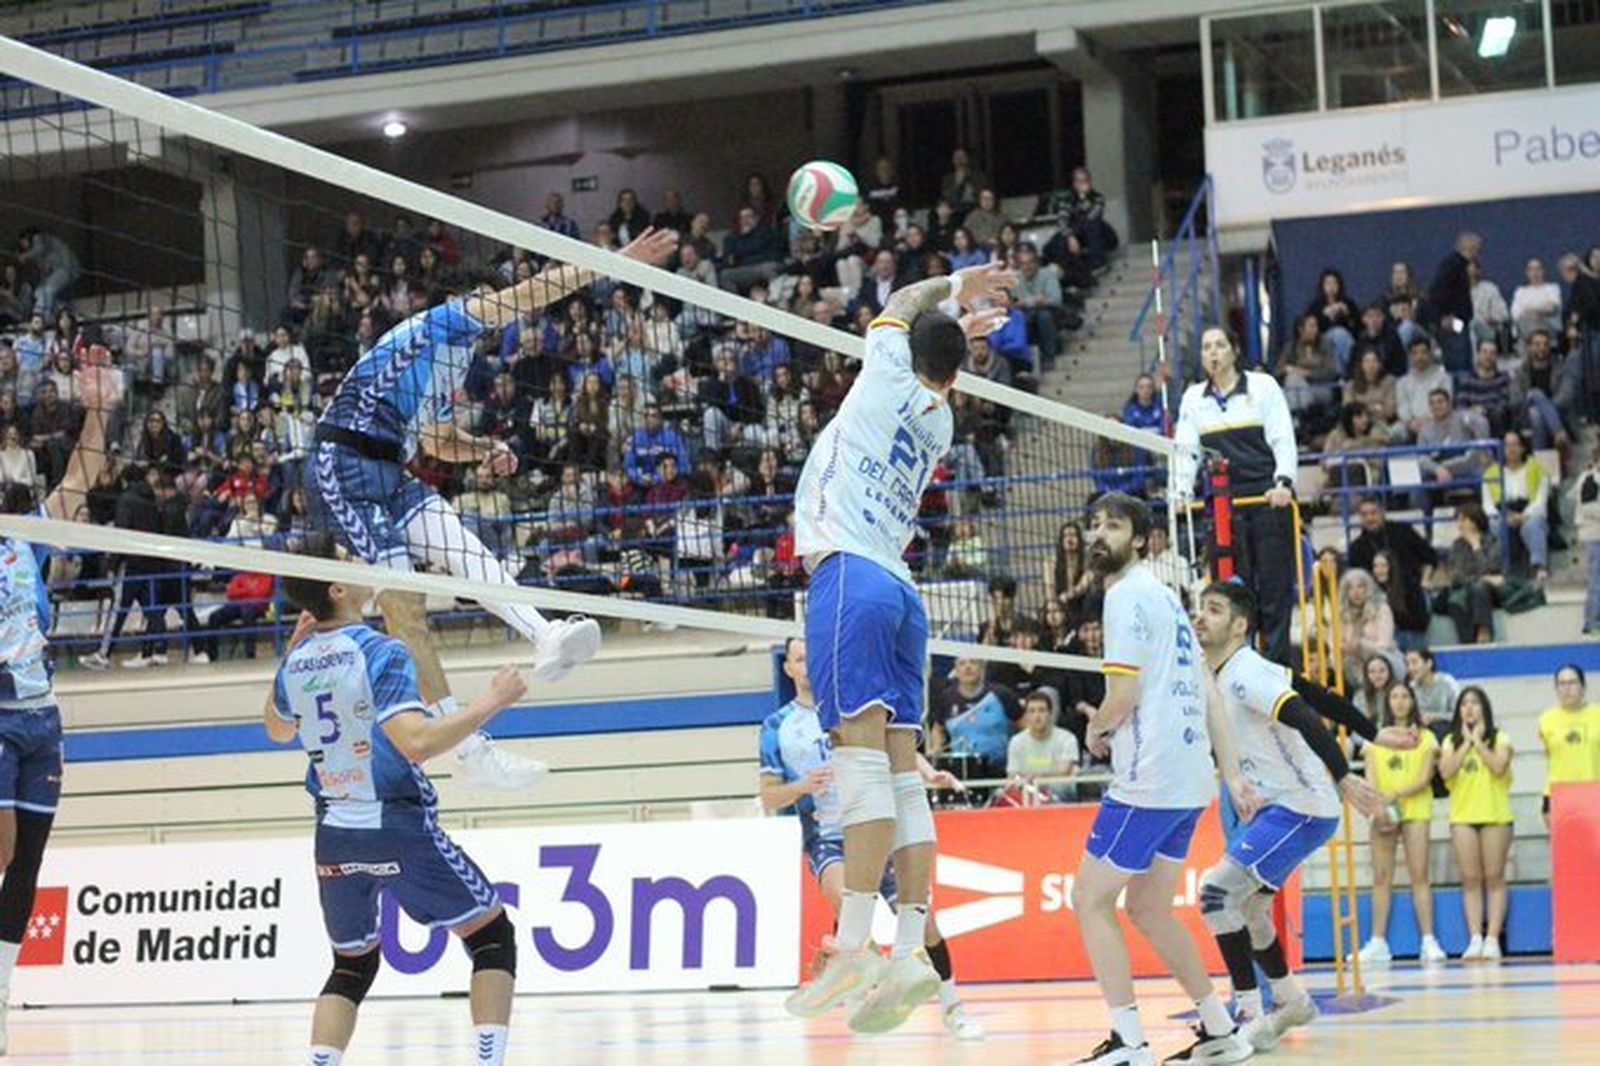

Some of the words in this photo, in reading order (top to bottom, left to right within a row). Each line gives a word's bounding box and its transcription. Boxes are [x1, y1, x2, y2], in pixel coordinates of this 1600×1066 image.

[1302, 140, 1406, 174] Leganés
[1493, 124, 1600, 166] Pabe
[316, 692, 341, 744] 5
[76, 878, 282, 916] Comunidad
[73, 930, 121, 965] de
[136, 924, 278, 963] Madrid
